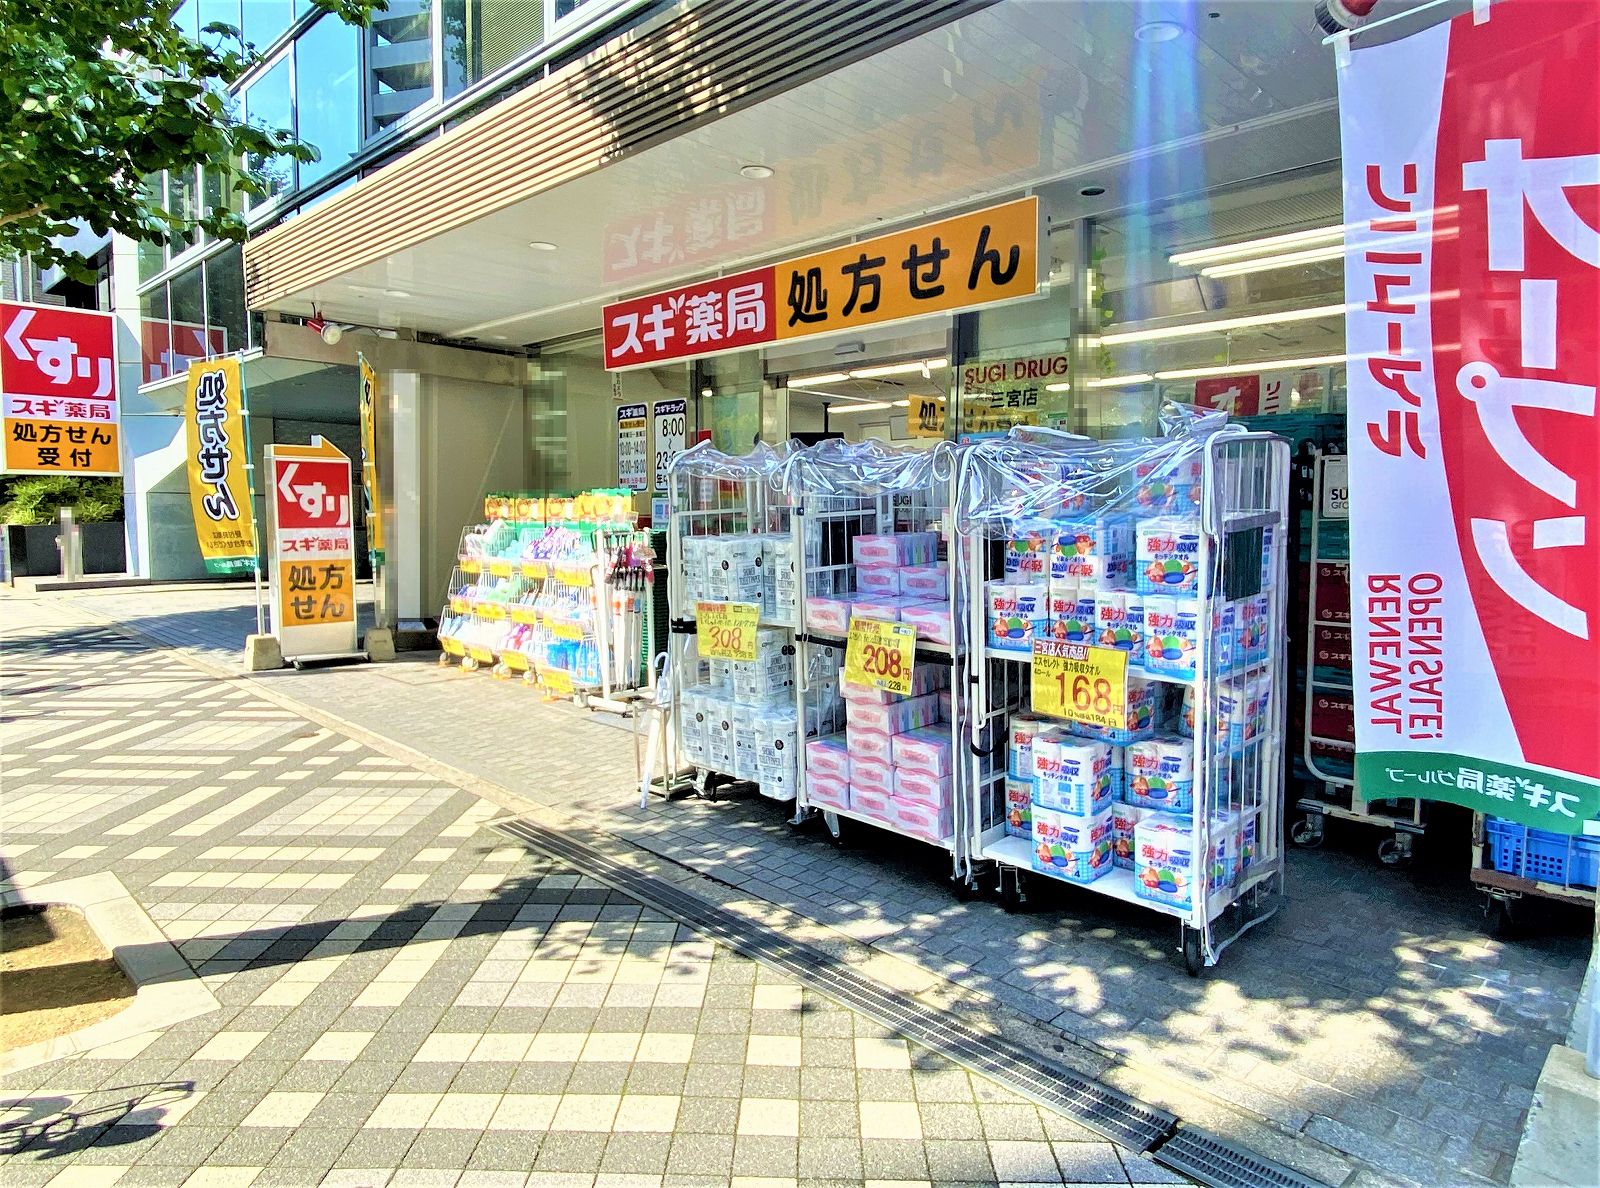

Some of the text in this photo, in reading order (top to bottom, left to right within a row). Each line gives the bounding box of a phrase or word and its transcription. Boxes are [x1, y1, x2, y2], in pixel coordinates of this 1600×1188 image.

[611, 225, 1020, 358] スギ薬局 処方せん
[3, 309, 112, 397] くすり
[965, 357, 1068, 384] SUGI DRUG
[11, 399, 111, 420] スギ薬局
[991, 388, 1039, 409] 三宮店
[12, 421, 112, 446] 処方せん
[662, 417, 685, 437] 8:00
[37, 447, 92, 468] 受付
[277, 463, 349, 526] くすり
[281, 536, 349, 552] スギ薬局
[288, 564, 345, 591] 処方
[290, 594, 345, 619] せん
